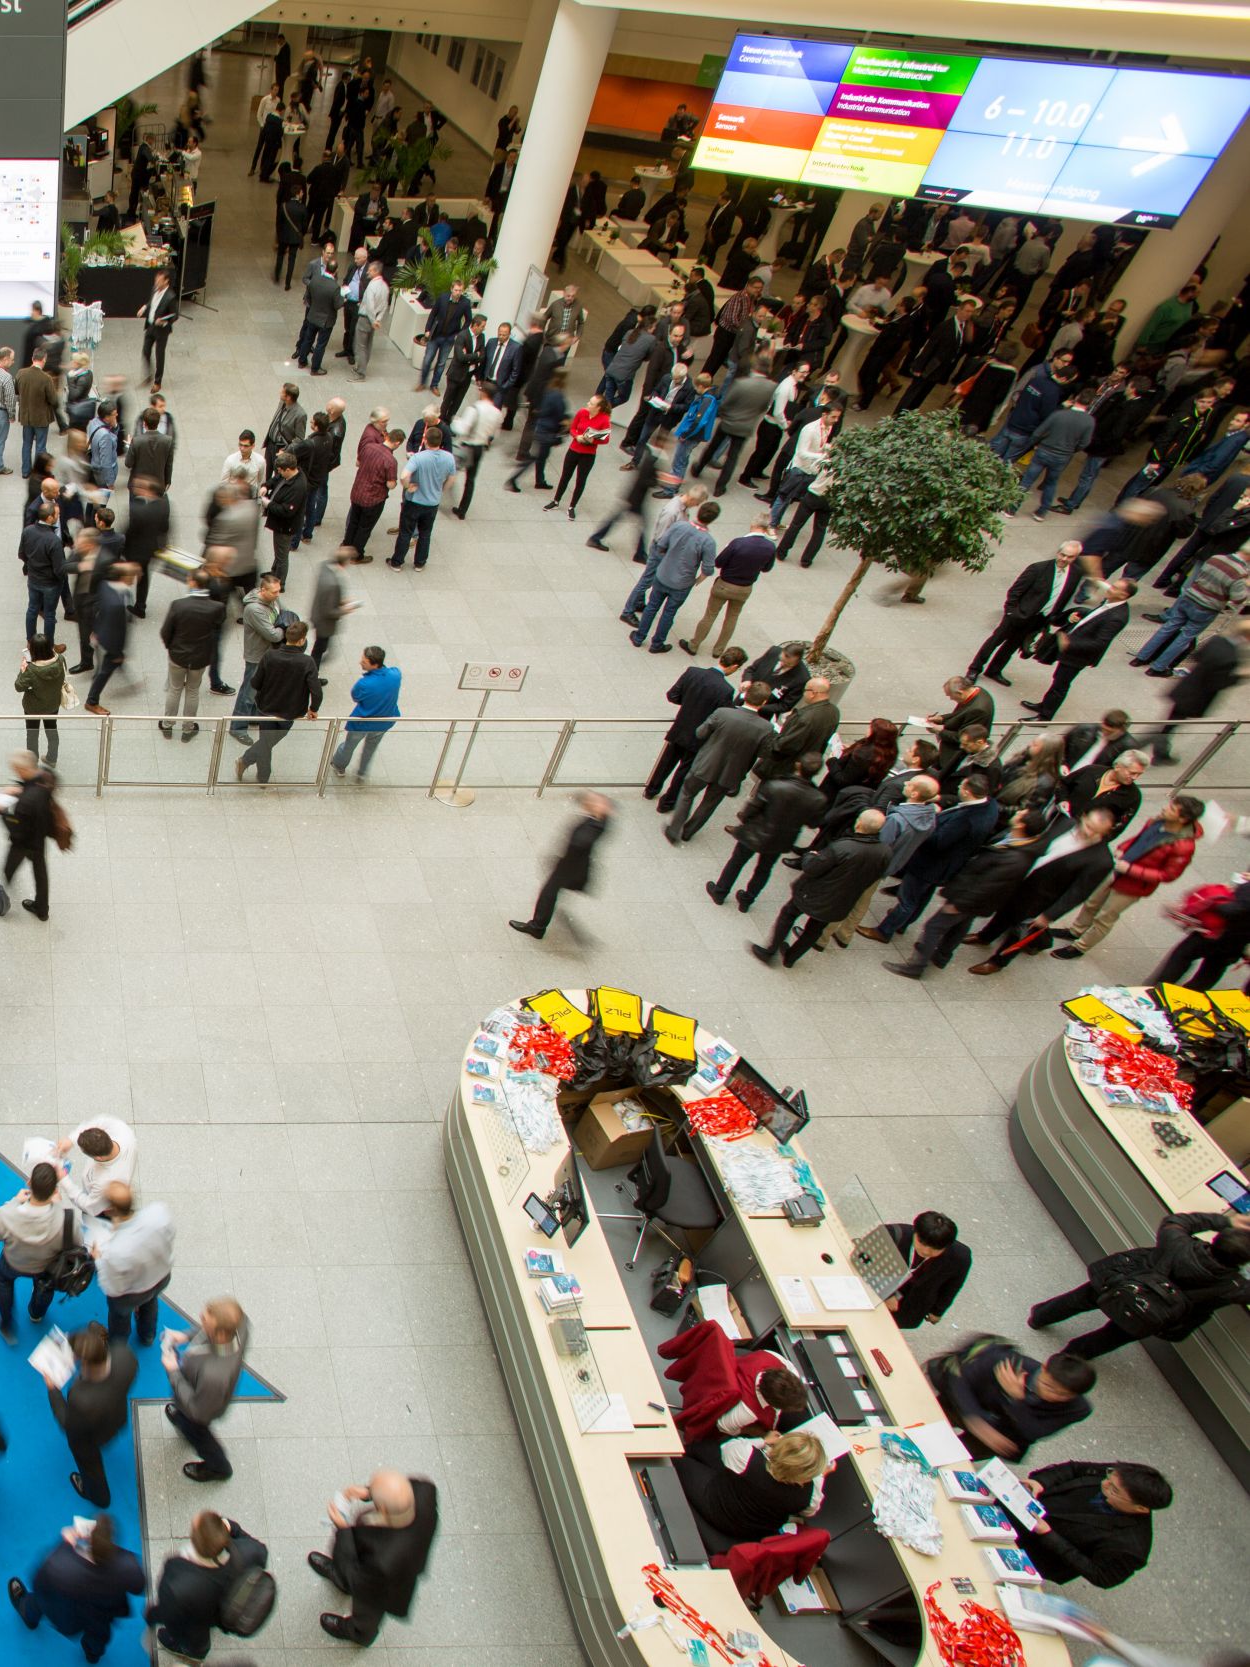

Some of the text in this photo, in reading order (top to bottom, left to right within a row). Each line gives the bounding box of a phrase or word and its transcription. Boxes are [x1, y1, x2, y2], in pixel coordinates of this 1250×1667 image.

[836, 101, 911, 117] Industrial communication
[840, 92, 930, 110] Industrielle Kommunikation
[984, 95, 1006, 120] 6
[1001, 131, 1058, 160] 11.0
[548, 1007, 572, 1022] PILZ
[604, 1007, 631, 1019] PILZ
[1090, 1012, 1115, 1025] PILZ
